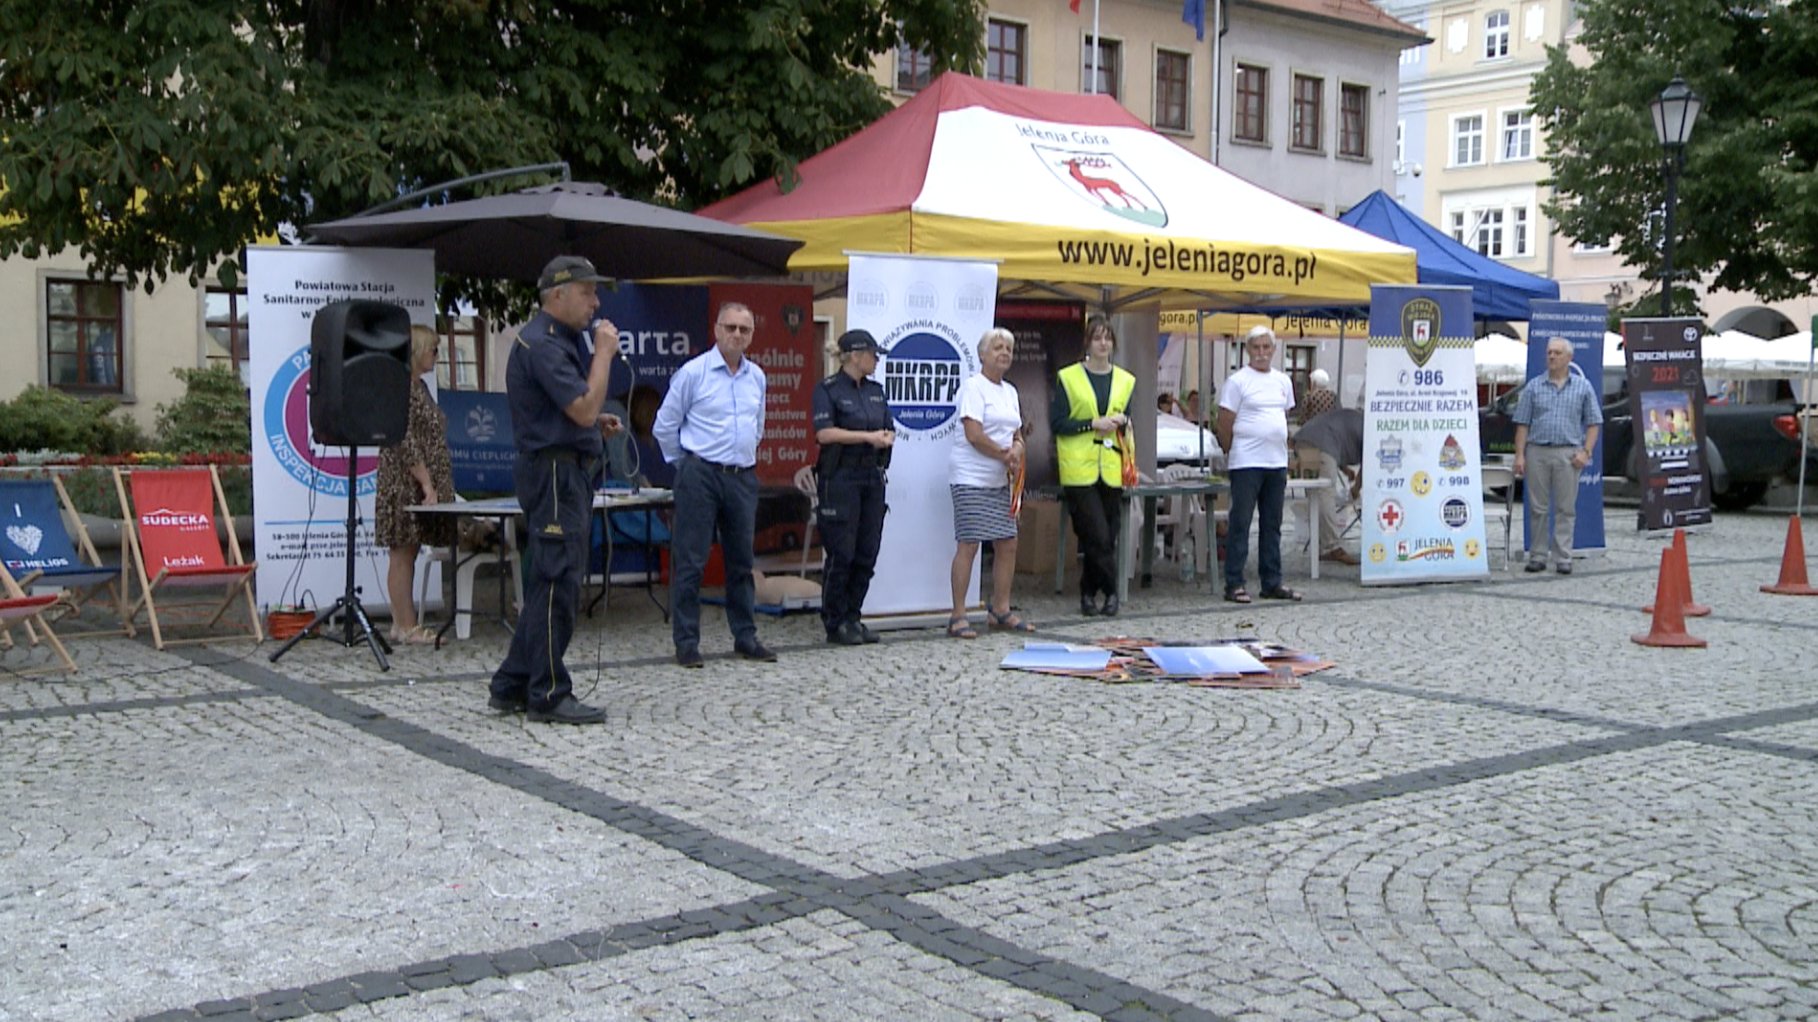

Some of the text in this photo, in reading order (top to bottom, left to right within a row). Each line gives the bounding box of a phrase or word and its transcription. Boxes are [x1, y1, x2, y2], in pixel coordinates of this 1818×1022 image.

[1058, 238, 1317, 286] www.jeleniagora.pl
[295, 280, 394, 294] Powiatowa Stacja
[766, 372, 802, 390] amy
[885, 361, 961, 402] MKRPA
[1414, 369, 1444, 386] 986
[1370, 399, 1474, 413] BEZPIECZNIE RAZEM
[1376, 417, 1468, 432] RAZEM DLA DZIECI
[778, 446, 808, 464] Góry
[1386, 475, 1470, 489] 997 998
[15, 503, 22, 518] I
[142, 514, 209, 525] SUDECKA
[1414, 536, 1454, 551] JELENIA
[25, 557, 69, 568] HELIOS
[163, 554, 205, 567] Leżak
